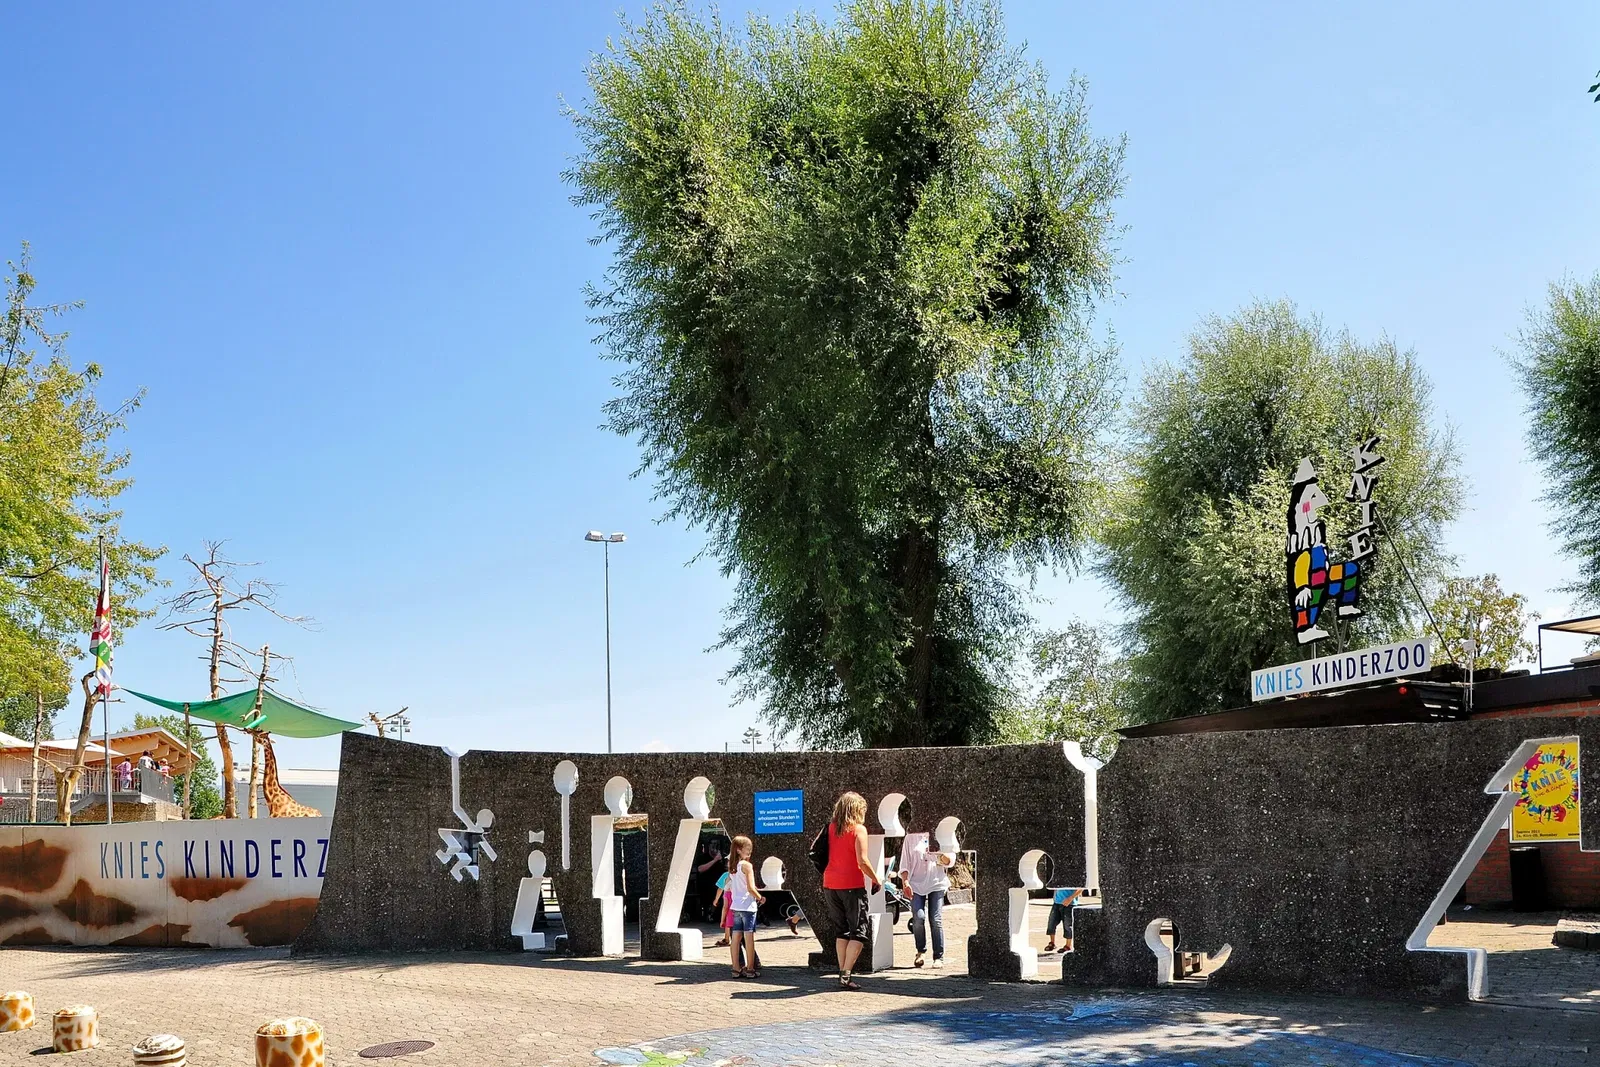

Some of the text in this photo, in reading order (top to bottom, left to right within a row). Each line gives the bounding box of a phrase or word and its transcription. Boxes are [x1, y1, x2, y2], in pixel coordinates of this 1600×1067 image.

[1346, 437, 1384, 561] KNIE
[1255, 643, 1425, 696] KNIES KINDERZOO
[1531, 769, 1566, 791] KNIE
[100, 840, 166, 880] KNIES
